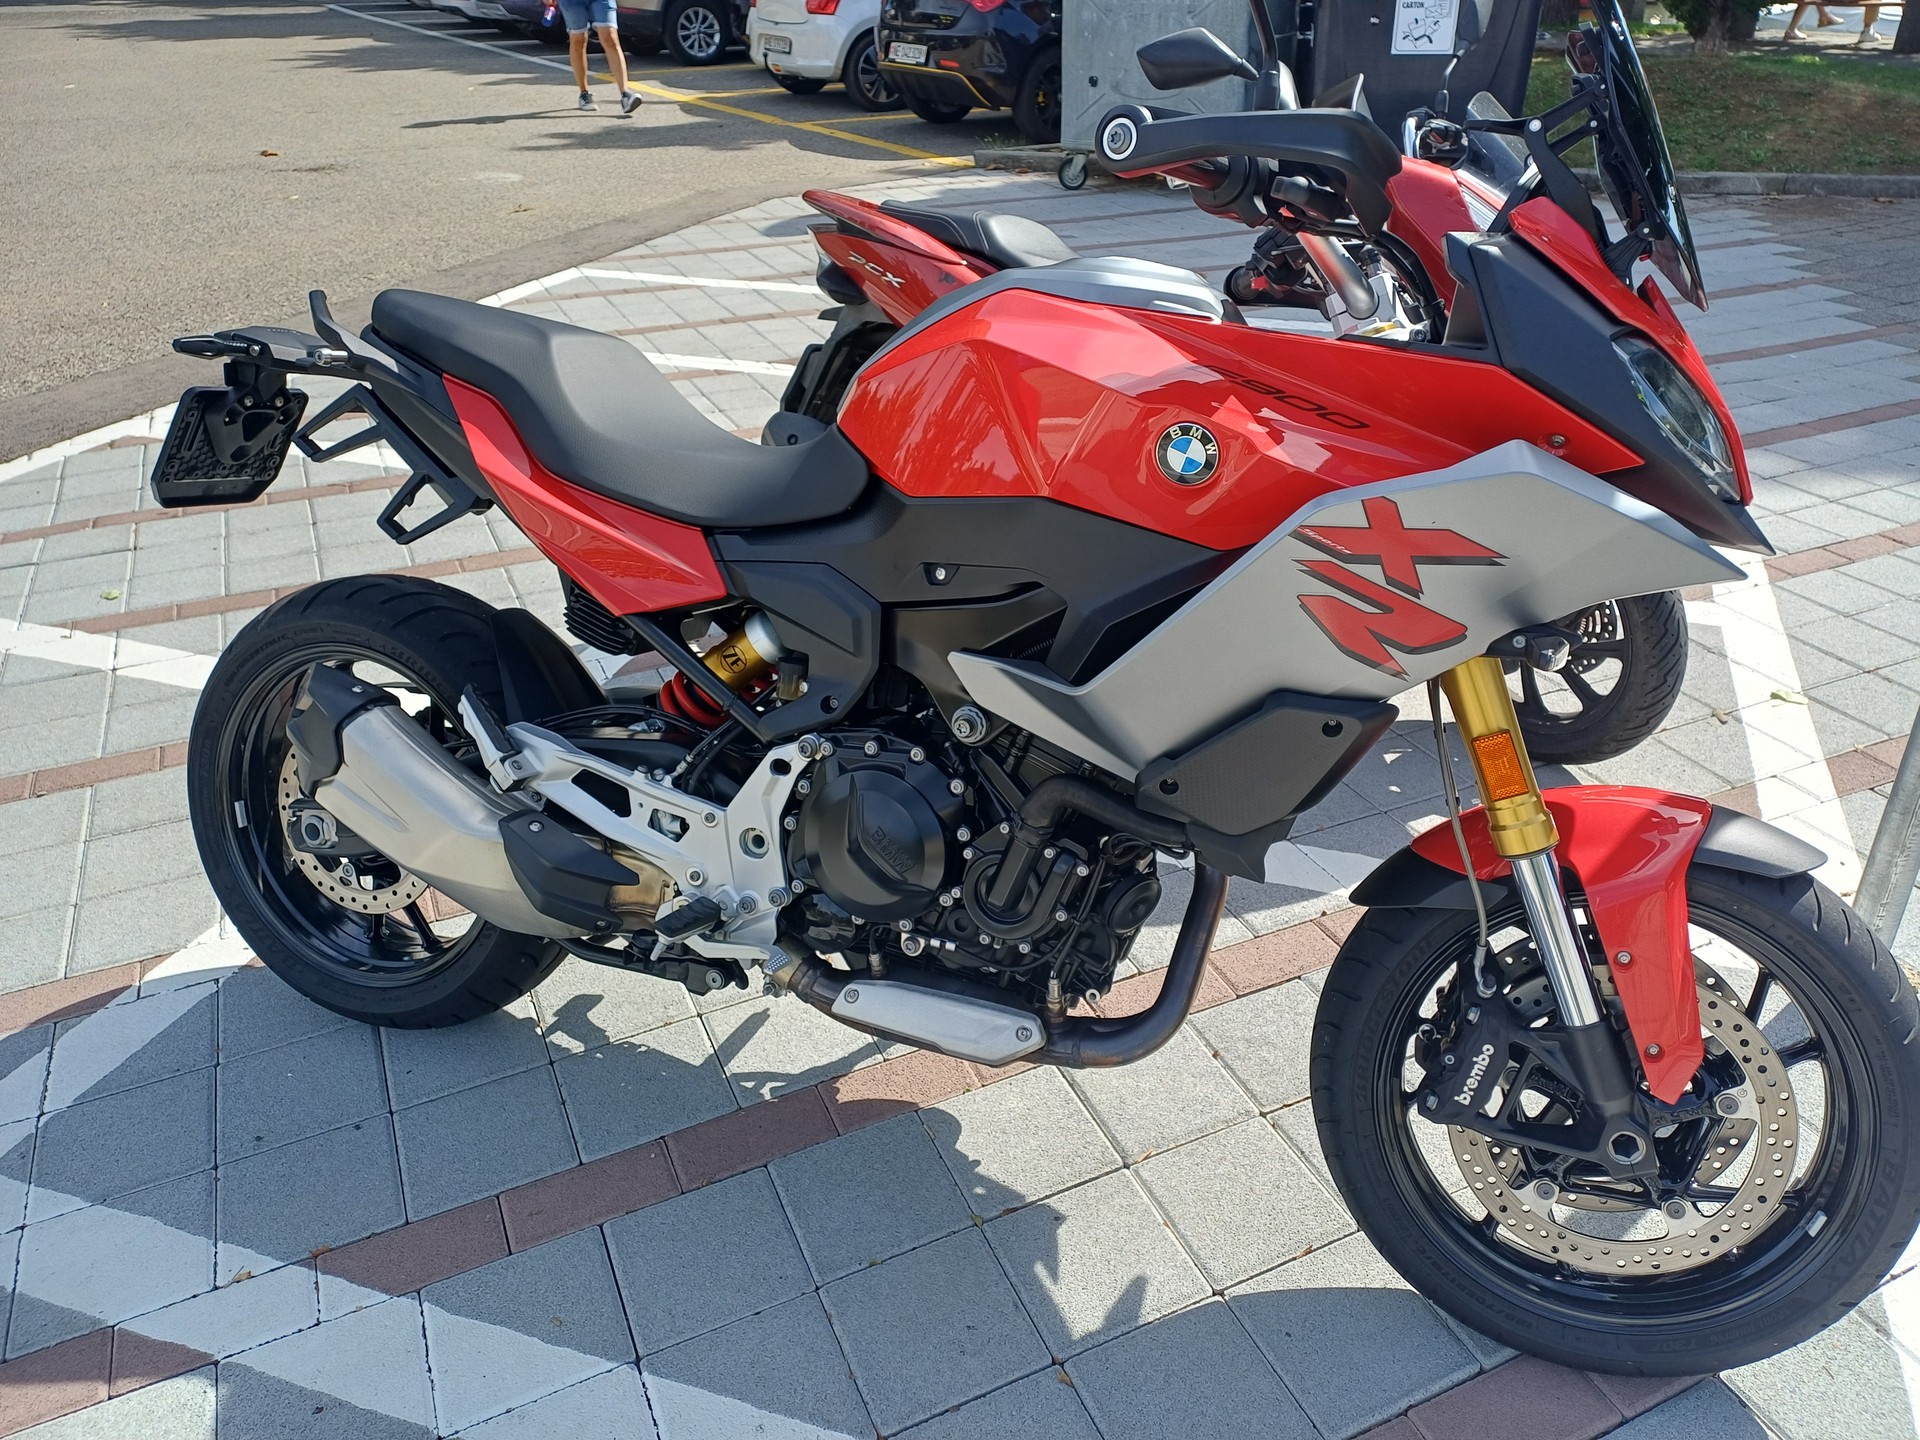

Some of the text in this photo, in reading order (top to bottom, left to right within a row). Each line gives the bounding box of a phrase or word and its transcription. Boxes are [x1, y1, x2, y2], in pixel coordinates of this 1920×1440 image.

[1402, 1, 1425, 9] CARTON
[847, 250, 906, 288] PCX
[1169, 426, 1217, 455] BMW
[870, 825, 916, 874] BMW
[1454, 1044, 1495, 1106] brembo
